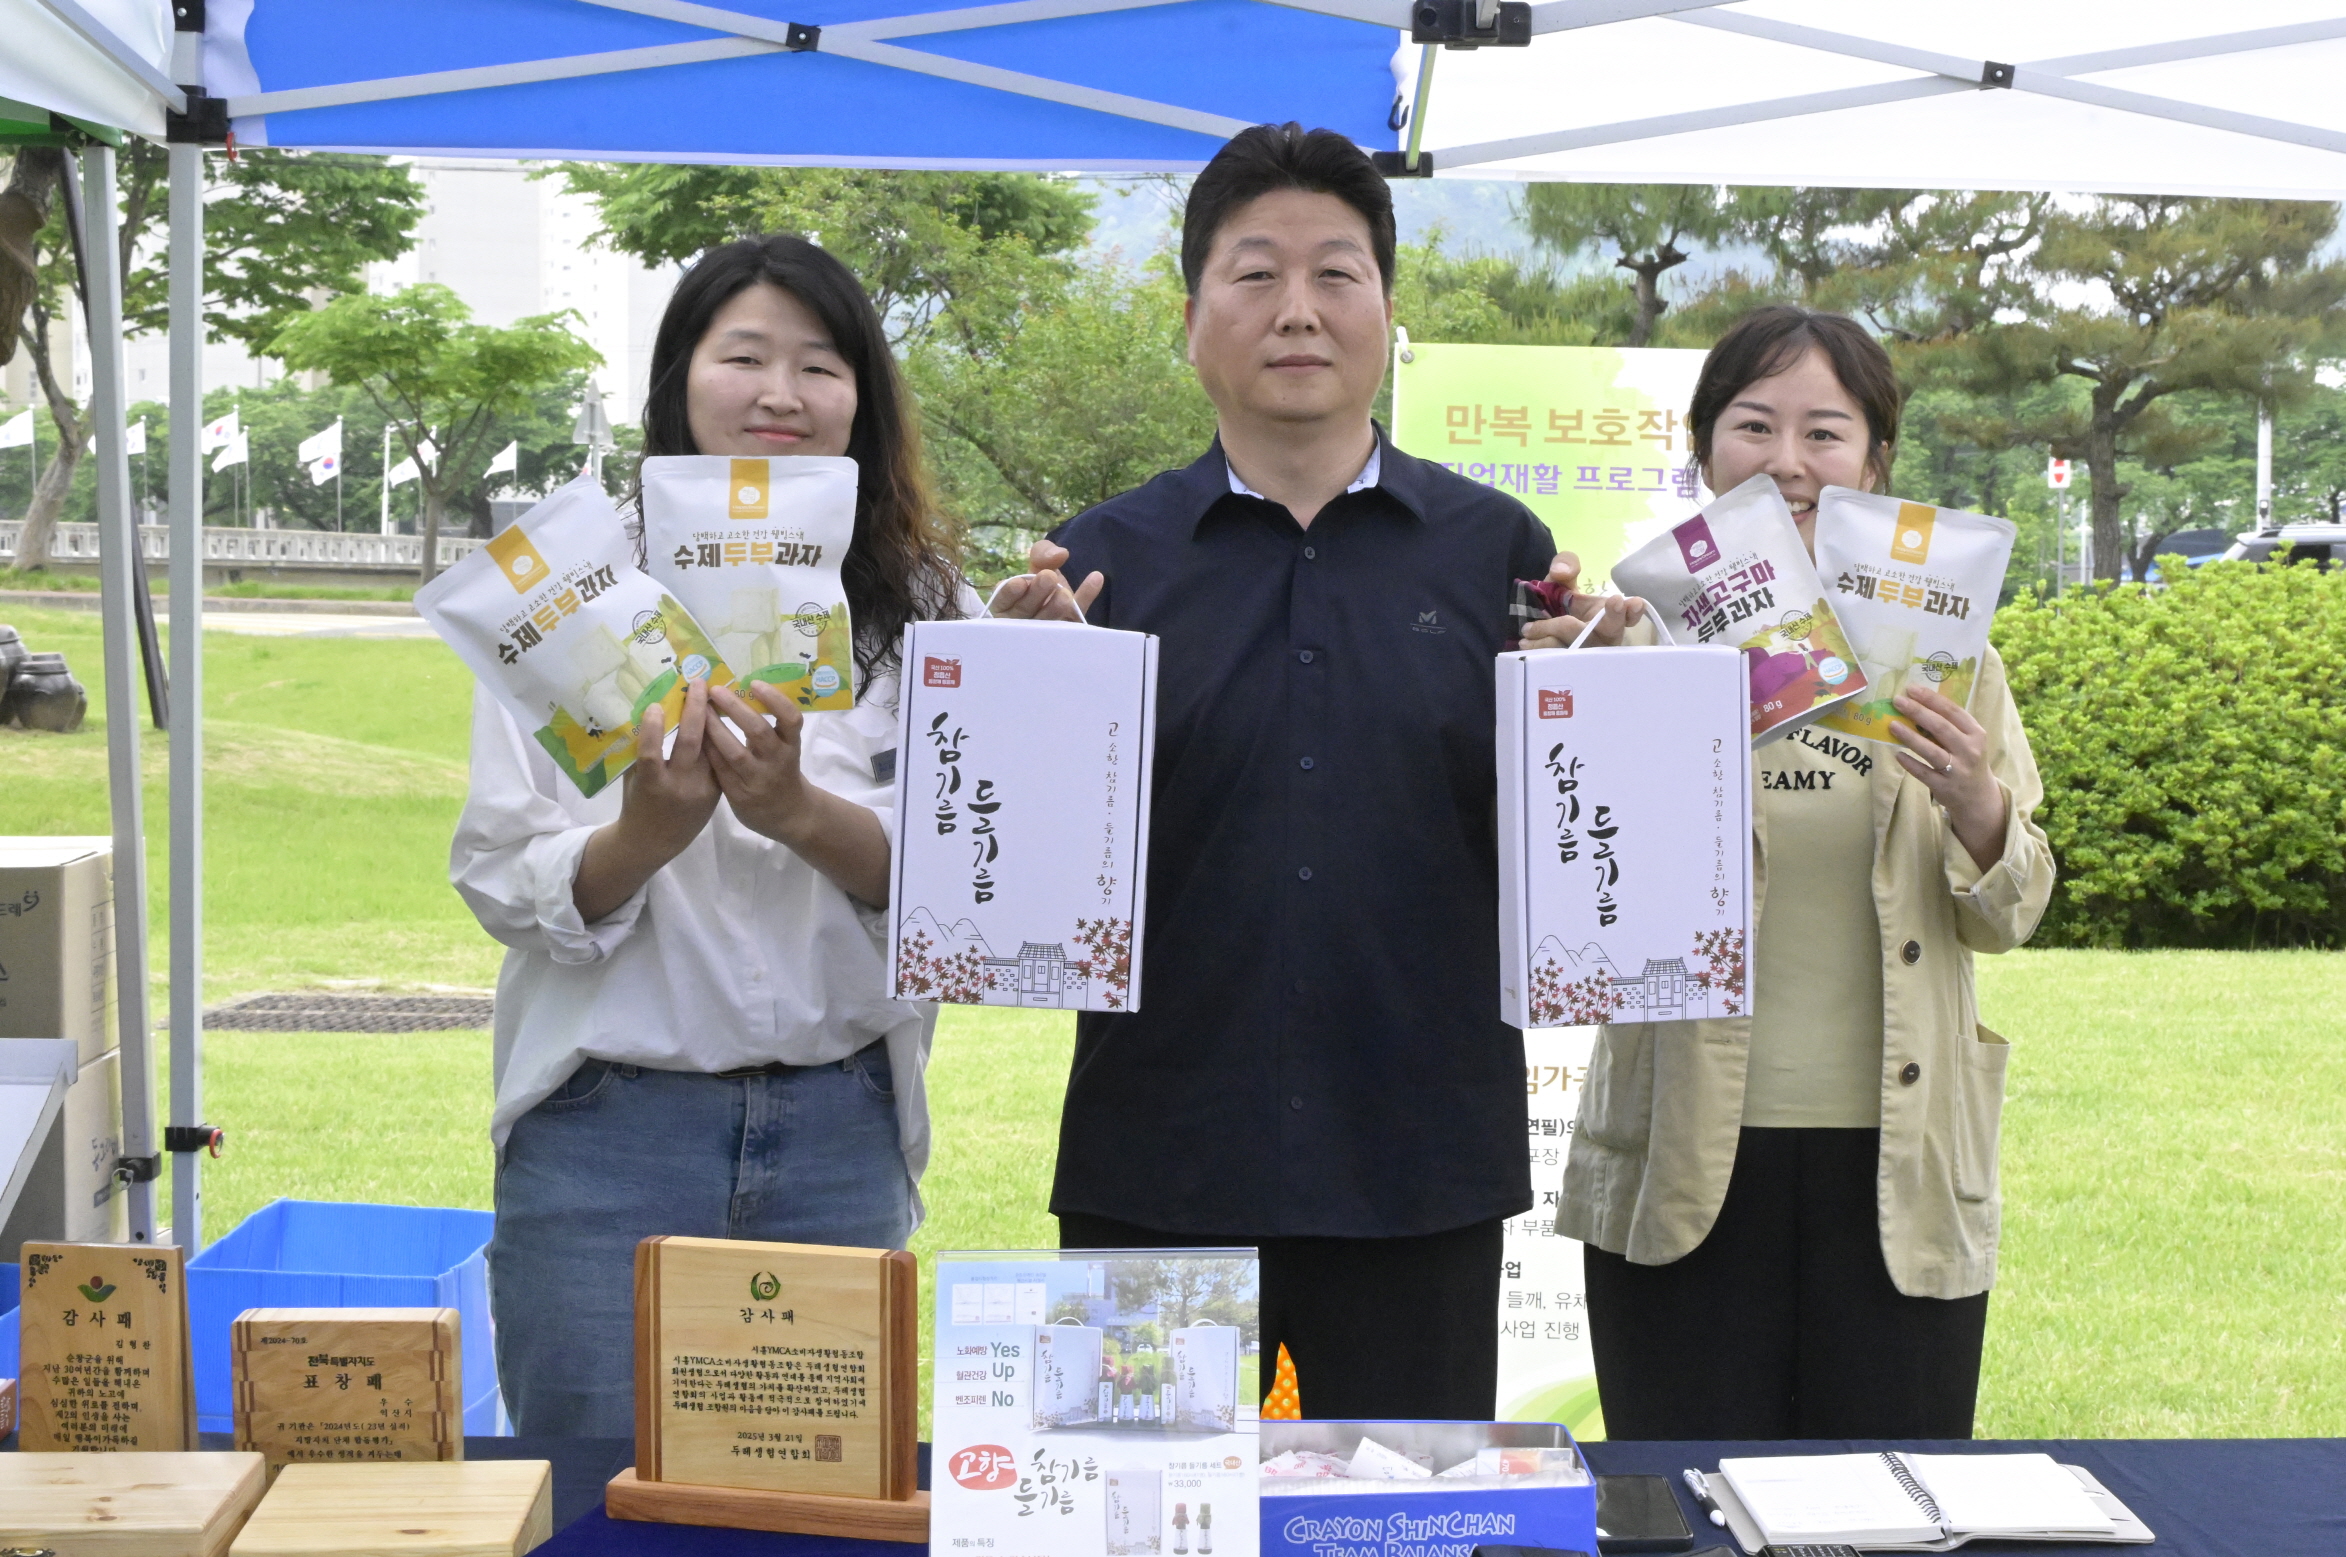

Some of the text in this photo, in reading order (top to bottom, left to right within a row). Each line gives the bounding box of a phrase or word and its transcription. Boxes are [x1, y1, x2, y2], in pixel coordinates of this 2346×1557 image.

[1446, 404, 1532, 447] 만복
[1573, 467, 1699, 498] 프로그램
[727, 530, 749, 540] 고소한
[753, 529, 768, 540] 건강
[1885, 571, 1905, 582] 고소한
[1908, 574, 1921, 585] 건강
[528, 592, 549, 613] 고소한
[547, 581, 563, 595] 건강
[1681, 559, 1776, 631] 자색고구마
[792, 610, 830, 629] 국내산 수제
[1698, 587, 1775, 643] 두부과자
[635, 610, 664, 644] 국내산 수제
[1780, 612, 1813, 638] 국내산 수제
[685, 660, 704, 675] HACCP
[1921, 662, 1958, 672] 국내산 수제
[1763, 700, 1783, 713] 80 g
[1853, 713, 1872, 726] 80 g
[1107, 722, 1119, 765] 고소한
[1712, 738, 1724, 781] 고소한
[927, 712, 969, 835] 참기름
[1545, 742, 1585, 864] 참기름
[968, 780, 1001, 904] 들기름
[1587, 805, 1619, 927] 들기름
[1096, 873, 1117, 905] 향기
[1710, 886, 1729, 916] 향기
[1500, 1320, 1579, 1341] 사업 진행
[957, 1342, 1020, 1357] 노화예방 Yes
[107, 1355, 124, 1365] 위해
[308, 1353, 376, 1367] 전북특별자치도
[43, 1364, 60, 1373] 지난
[956, 1362, 1015, 1382] 혈관건강 Up
[52, 1376, 79, 1385] 수많은
[731, 1369, 753, 1380] 다양한
[756, 1370, 779, 1381] 활동과
[782, 1372, 805, 1383] 연대를
[810, 1373, 823, 1383] 통해
[826, 1374, 865, 1385] 지역사회에
[68, 1388, 125, 1399] 귀하의 노고에
[673, 1390, 706, 1399] 연합회의
[711, 1391, 735, 1401] 사업과
[716, 1380, 755, 1391] 두레생협의
[760, 1382, 783, 1392] 가치를
[833, 1386, 865, 1397] 두레생협
[82, 1400, 108, 1410] 위로를
[955, 1391, 1014, 1406] 벤조피렌 No
[82, 1411, 108, 1421] 인생을
[113, 1413, 130, 1422] 사는
[673, 1402, 703, 1411] 두레생협
[706, 1403, 737, 1413] 조합원의
[765, 1406, 780, 1415] 담아
[783, 1406, 789, 1416] 이
[792, 1407, 823, 1418] 감사패를
[101, 1424, 128, 1434] 미래에
[737, 1431, 802, 1444] 2025년 3월 21일
[956, 1448, 1099, 1485] 고향 참기름
[1210, 1461, 1222, 1469] 세트
[1014, 1477, 1074, 1517] 들기름
[1284, 1516, 1383, 1543] CRAYON
[977, 1538, 994, 1547] 특징
